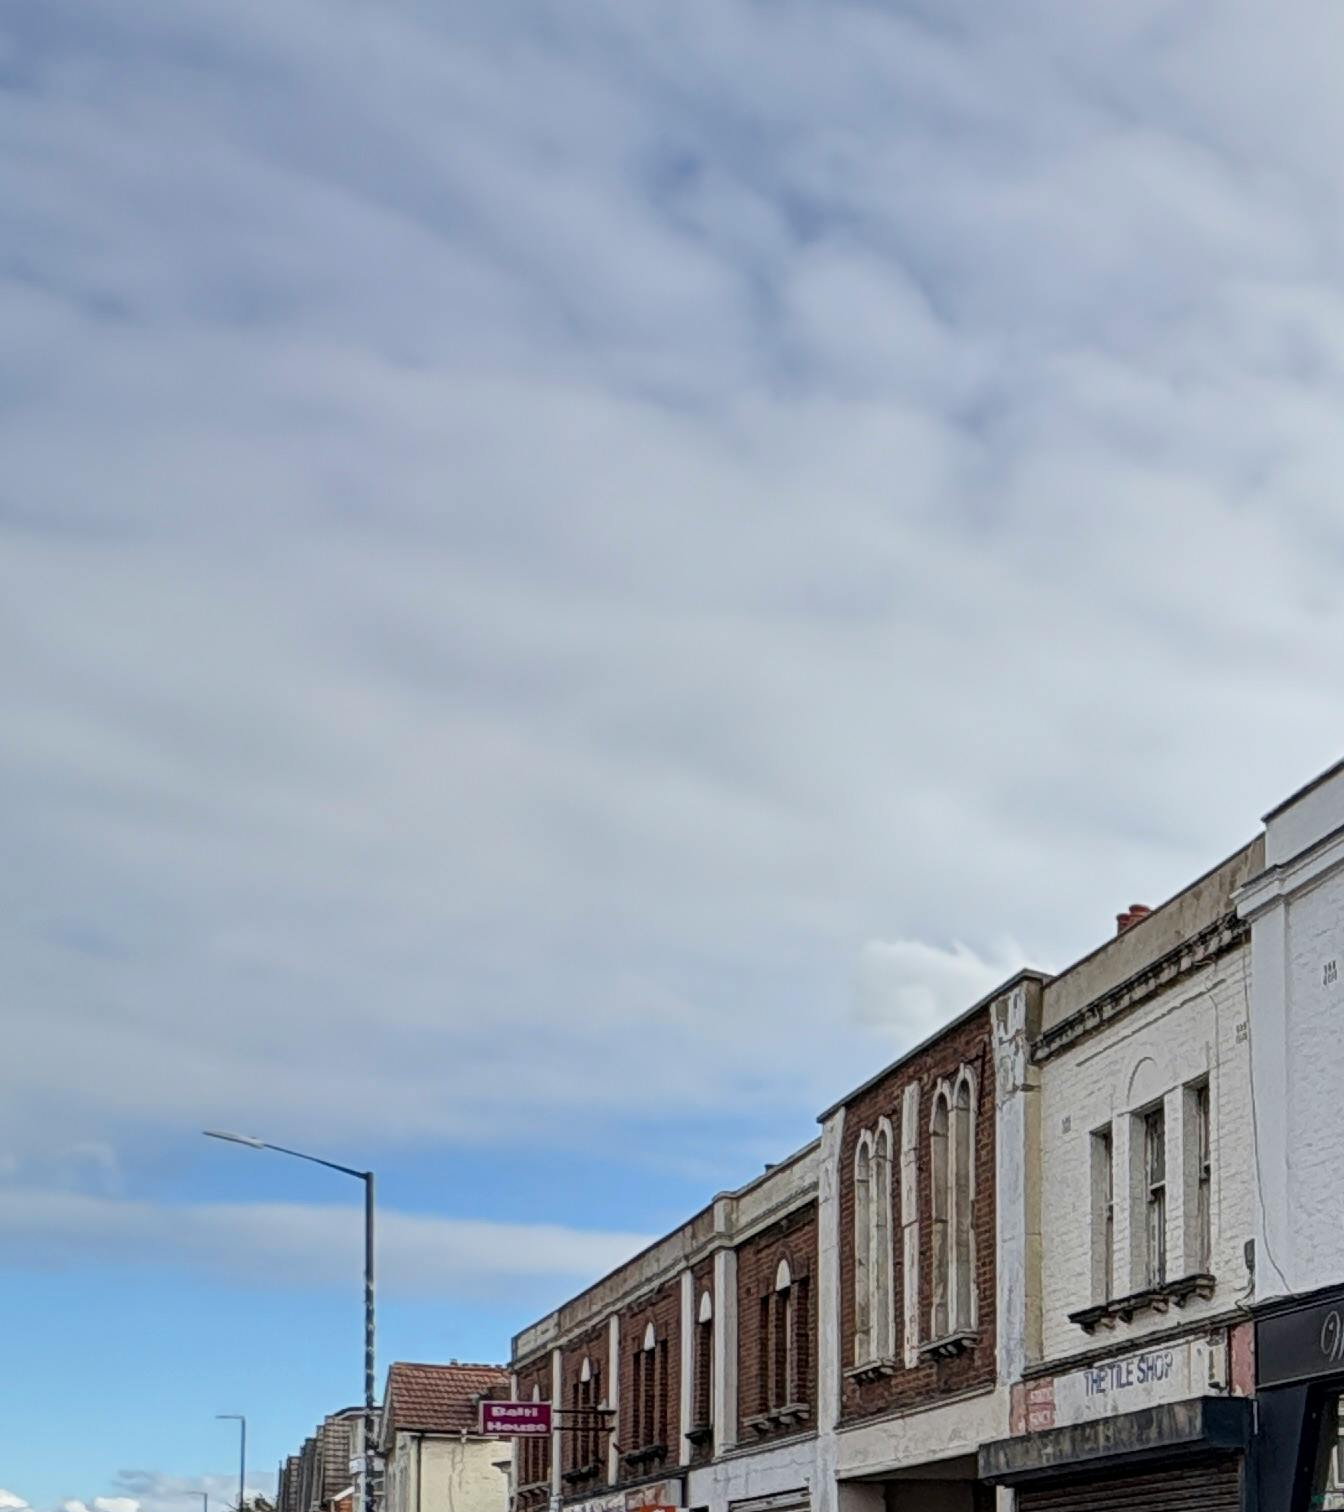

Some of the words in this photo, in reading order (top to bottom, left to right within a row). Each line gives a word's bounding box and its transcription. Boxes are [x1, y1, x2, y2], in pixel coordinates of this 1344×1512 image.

[1084, 1368, 1106, 1396] THE
[1108, 1360, 1134, 1391] TILE
[1137, 1352, 1173, 1384] SHOP
[491, 1406, 538, 1417] Balti
[487, 1420, 547, 1432] House
